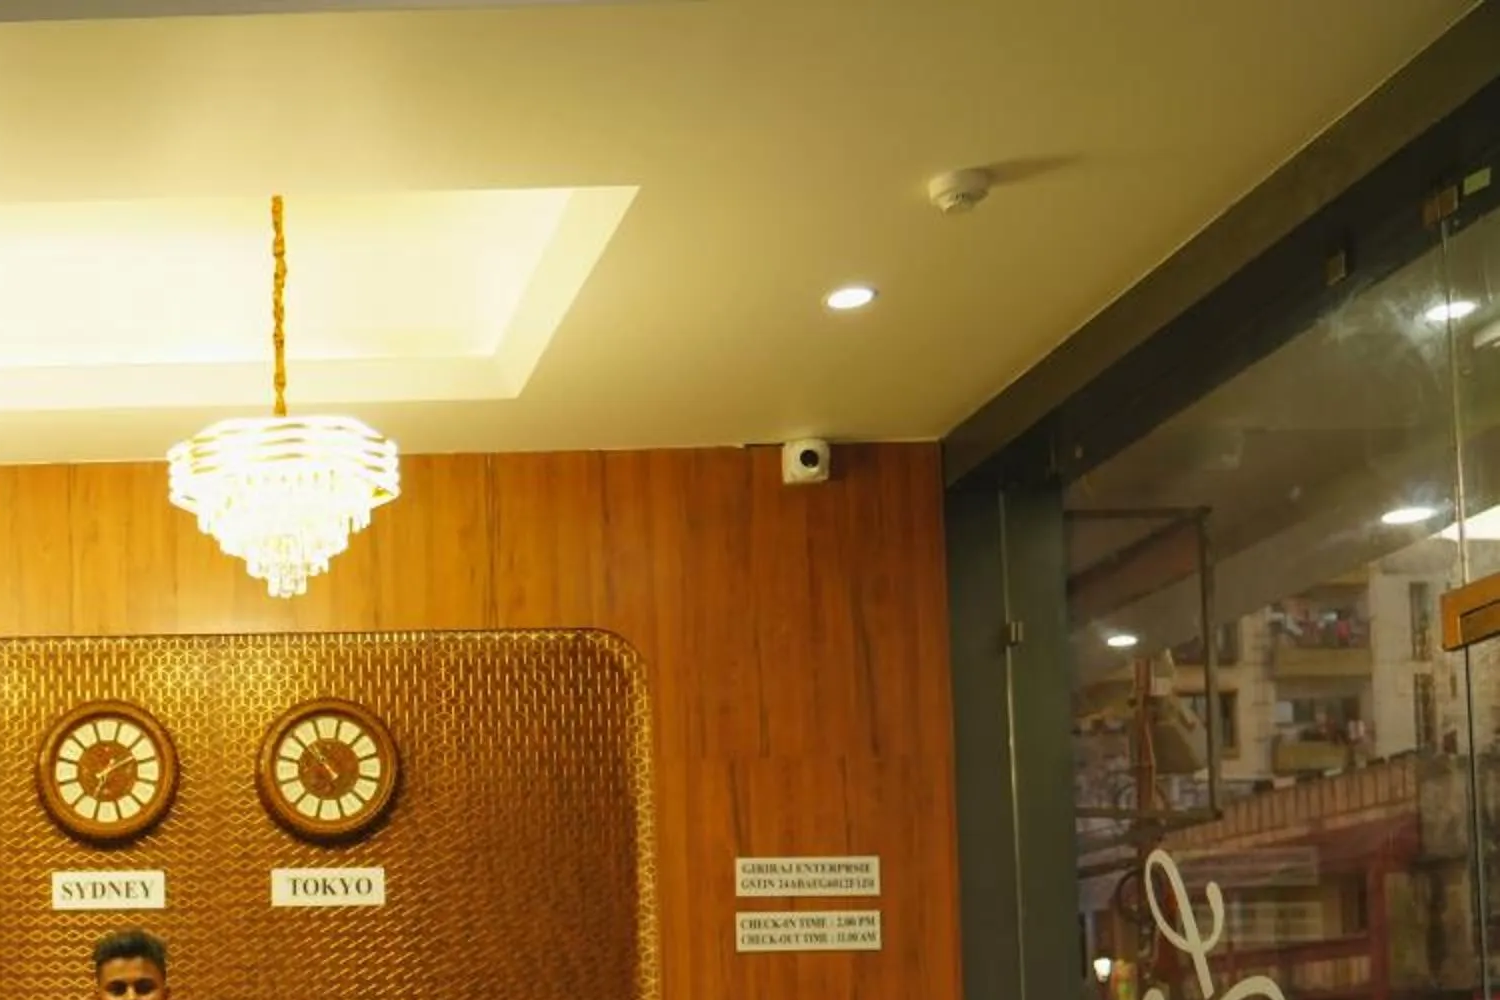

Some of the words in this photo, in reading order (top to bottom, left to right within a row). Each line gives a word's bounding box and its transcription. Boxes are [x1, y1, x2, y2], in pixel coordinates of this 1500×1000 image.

[60, 879, 156, 900] SYDNEY
[287, 876, 374, 896] TOKYO
[740, 918, 797, 929] CHECK-IN
[799, 917, 826, 929] TIME
[740, 933, 800, 945] CHECK-OUT
[802, 932, 828, 944] TIME
